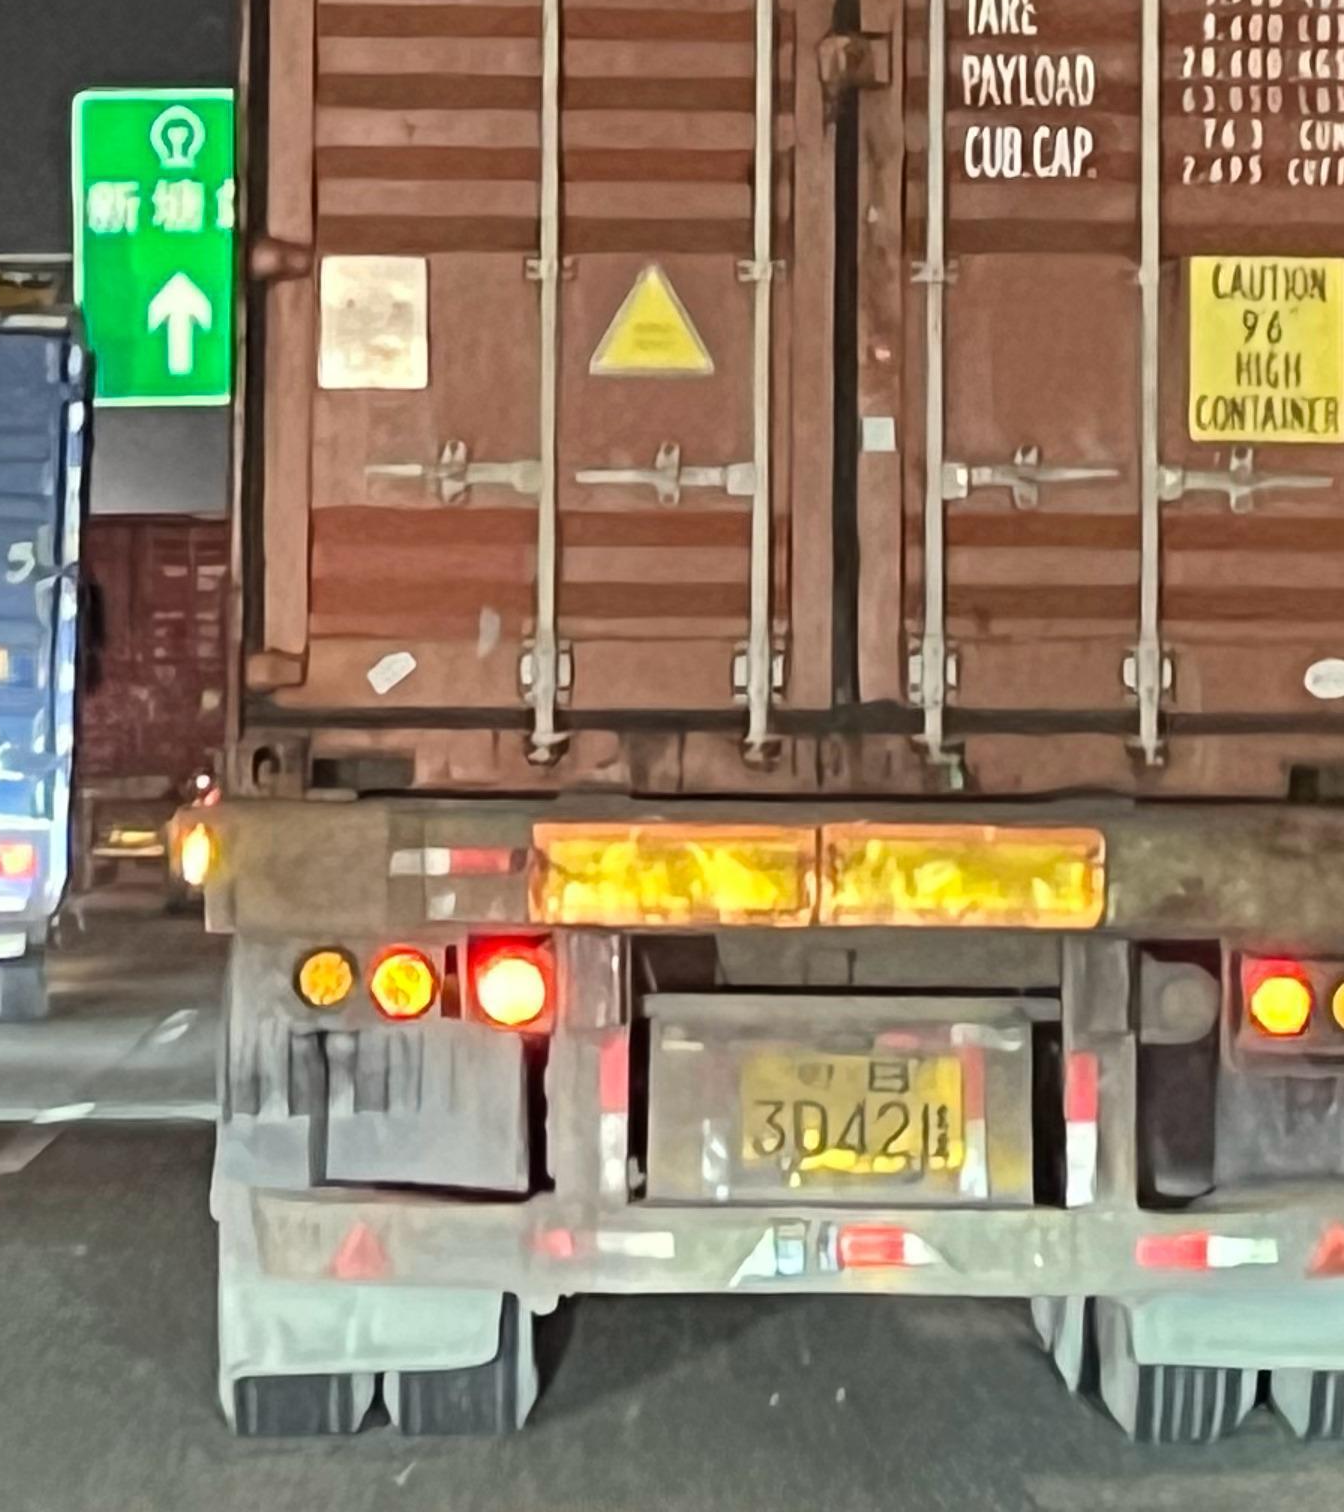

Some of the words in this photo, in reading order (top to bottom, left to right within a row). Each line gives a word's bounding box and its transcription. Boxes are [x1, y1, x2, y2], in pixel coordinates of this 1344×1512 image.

[962, 54, 1095, 107] PAYLOAD
[1212, 262, 1327, 303] CAUTION
[1235, 351, 1301, 389] HIGH
[1195, 394, 1340, 433] CONTAINER
